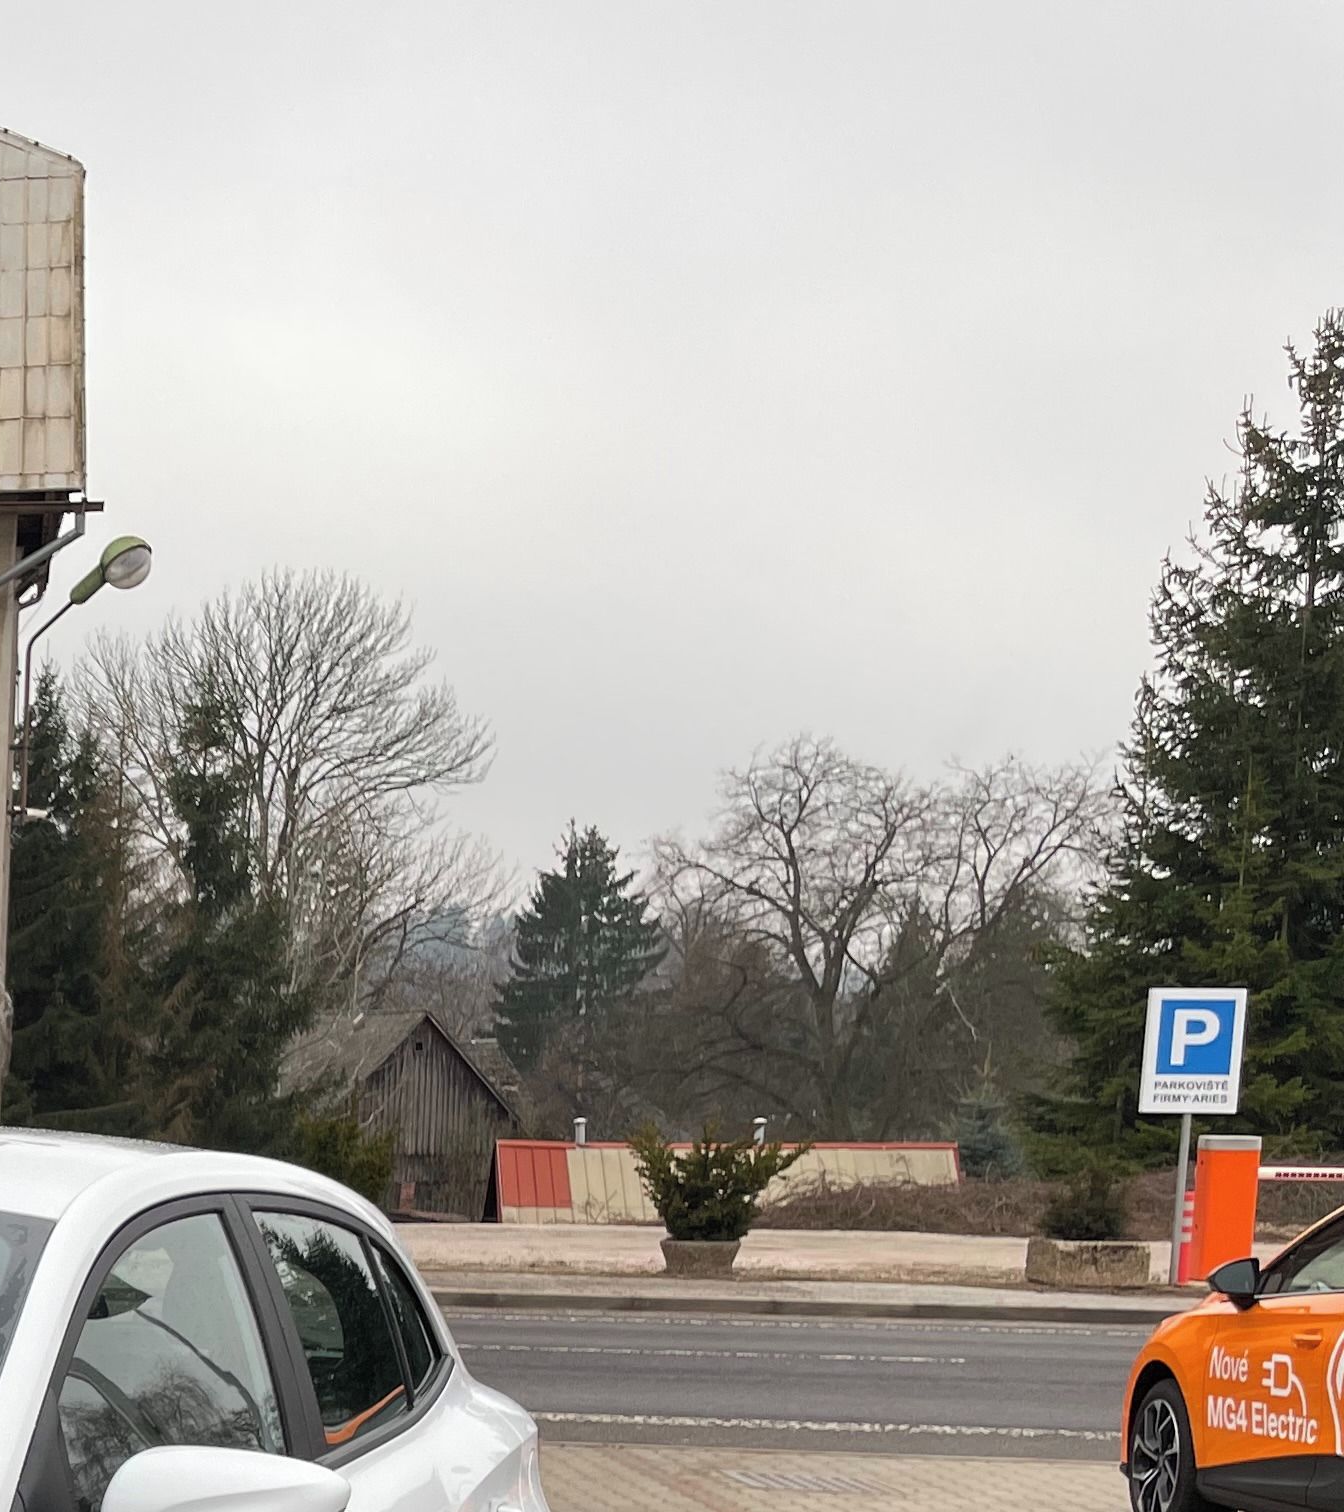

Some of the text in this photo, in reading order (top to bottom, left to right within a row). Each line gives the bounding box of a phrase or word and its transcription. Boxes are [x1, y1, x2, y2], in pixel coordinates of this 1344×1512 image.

[1169, 1008, 1221, 1067] P
[1152, 1093, 1189, 1104] FIRMY
[1153, 1080, 1229, 1091] PARKOVIŠTĚ
[1208, 1345, 1249, 1383] Nové
[1207, 1394, 1318, 1445] MG4 Electric
